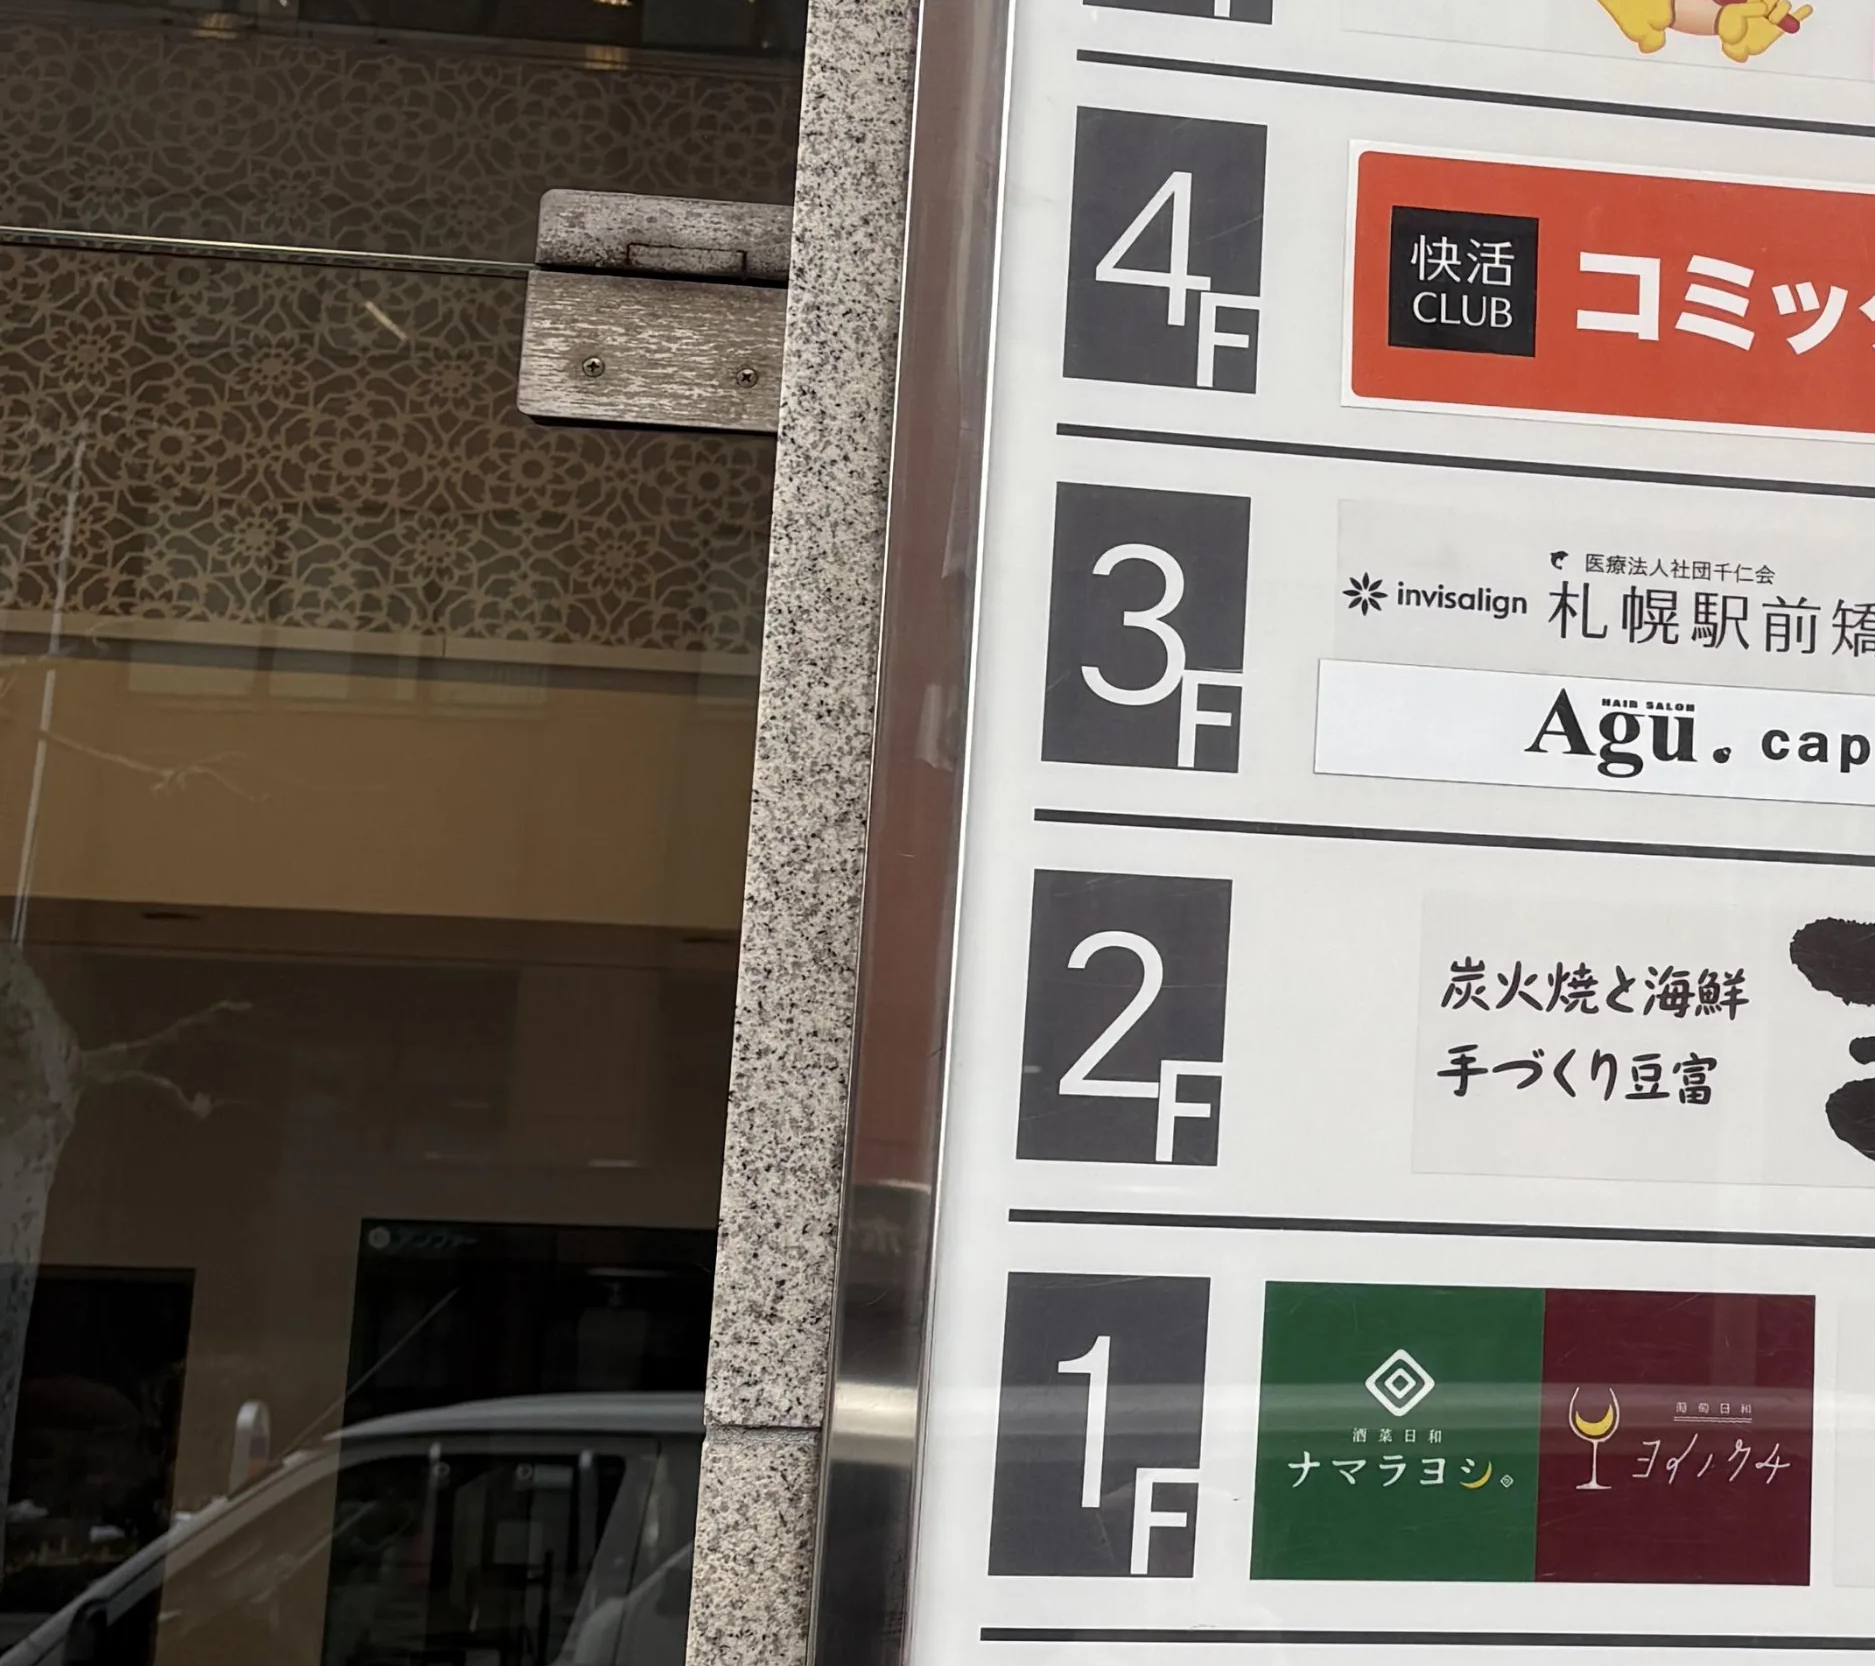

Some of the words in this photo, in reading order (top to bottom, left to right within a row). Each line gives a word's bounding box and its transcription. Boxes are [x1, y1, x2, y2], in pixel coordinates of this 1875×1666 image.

[1094, 170, 1262, 388] 4F
[1410, 235, 1515, 288] 快活
[1412, 290, 1514, 329] CLUB
[1396, 579, 1529, 620] invisalign
[1585, 552, 1777, 586] 医療法人社団千仁会
[1080, 542, 1244, 768] 3F
[1439, 955, 1751, 1021] 炭火焼と海鮮
[1058, 929, 1224, 1163] 2F
[1436, 1043, 1719, 1106] 手づくり豆富
[1057, 1335, 1200, 1575] 1F
